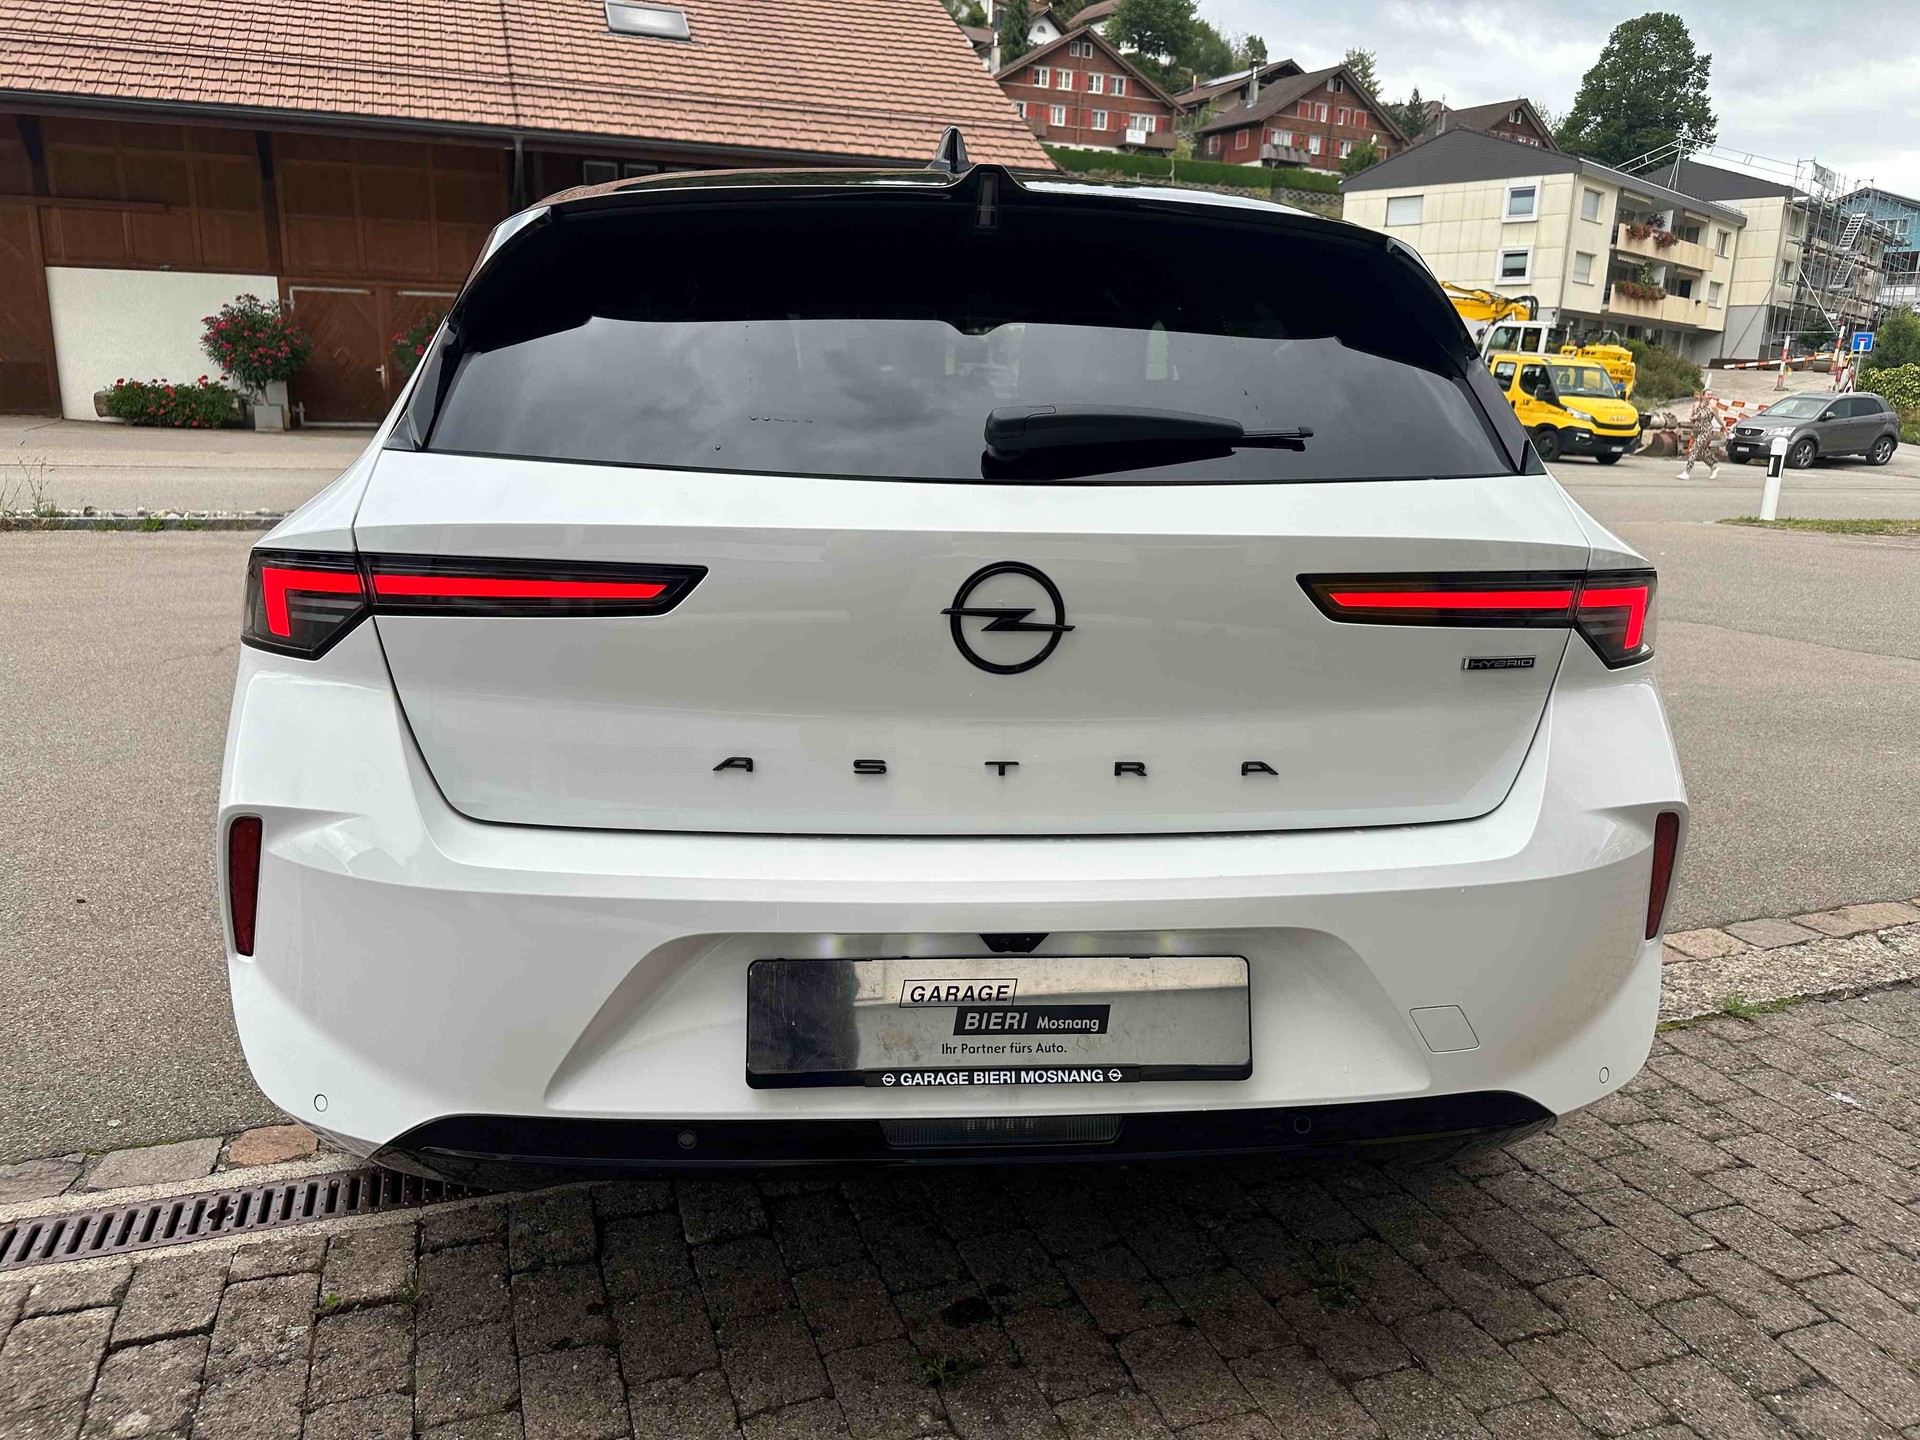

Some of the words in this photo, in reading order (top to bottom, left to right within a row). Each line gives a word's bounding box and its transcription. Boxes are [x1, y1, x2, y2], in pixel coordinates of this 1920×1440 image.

[1470, 659, 1533, 668] HYBRID
[712, 756, 1279, 777] ASTRA
[910, 984, 1010, 1003] GARAGE
[964, 1012, 1029, 1030] BIERI
[1036, 1016, 1100, 1032] Mosnang
[941, 1043, 957, 1054] Ihr
[961, 1043, 1006, 1054] Partner
[1009, 1042, 1033, 1054] fürs
[1035, 1042, 1067, 1054] Auto.
[900, 1072, 969, 1086] GARAGE
[974, 1071, 1015, 1085] BIERI
[1020, 1069, 1104, 1084] MOSNANG
